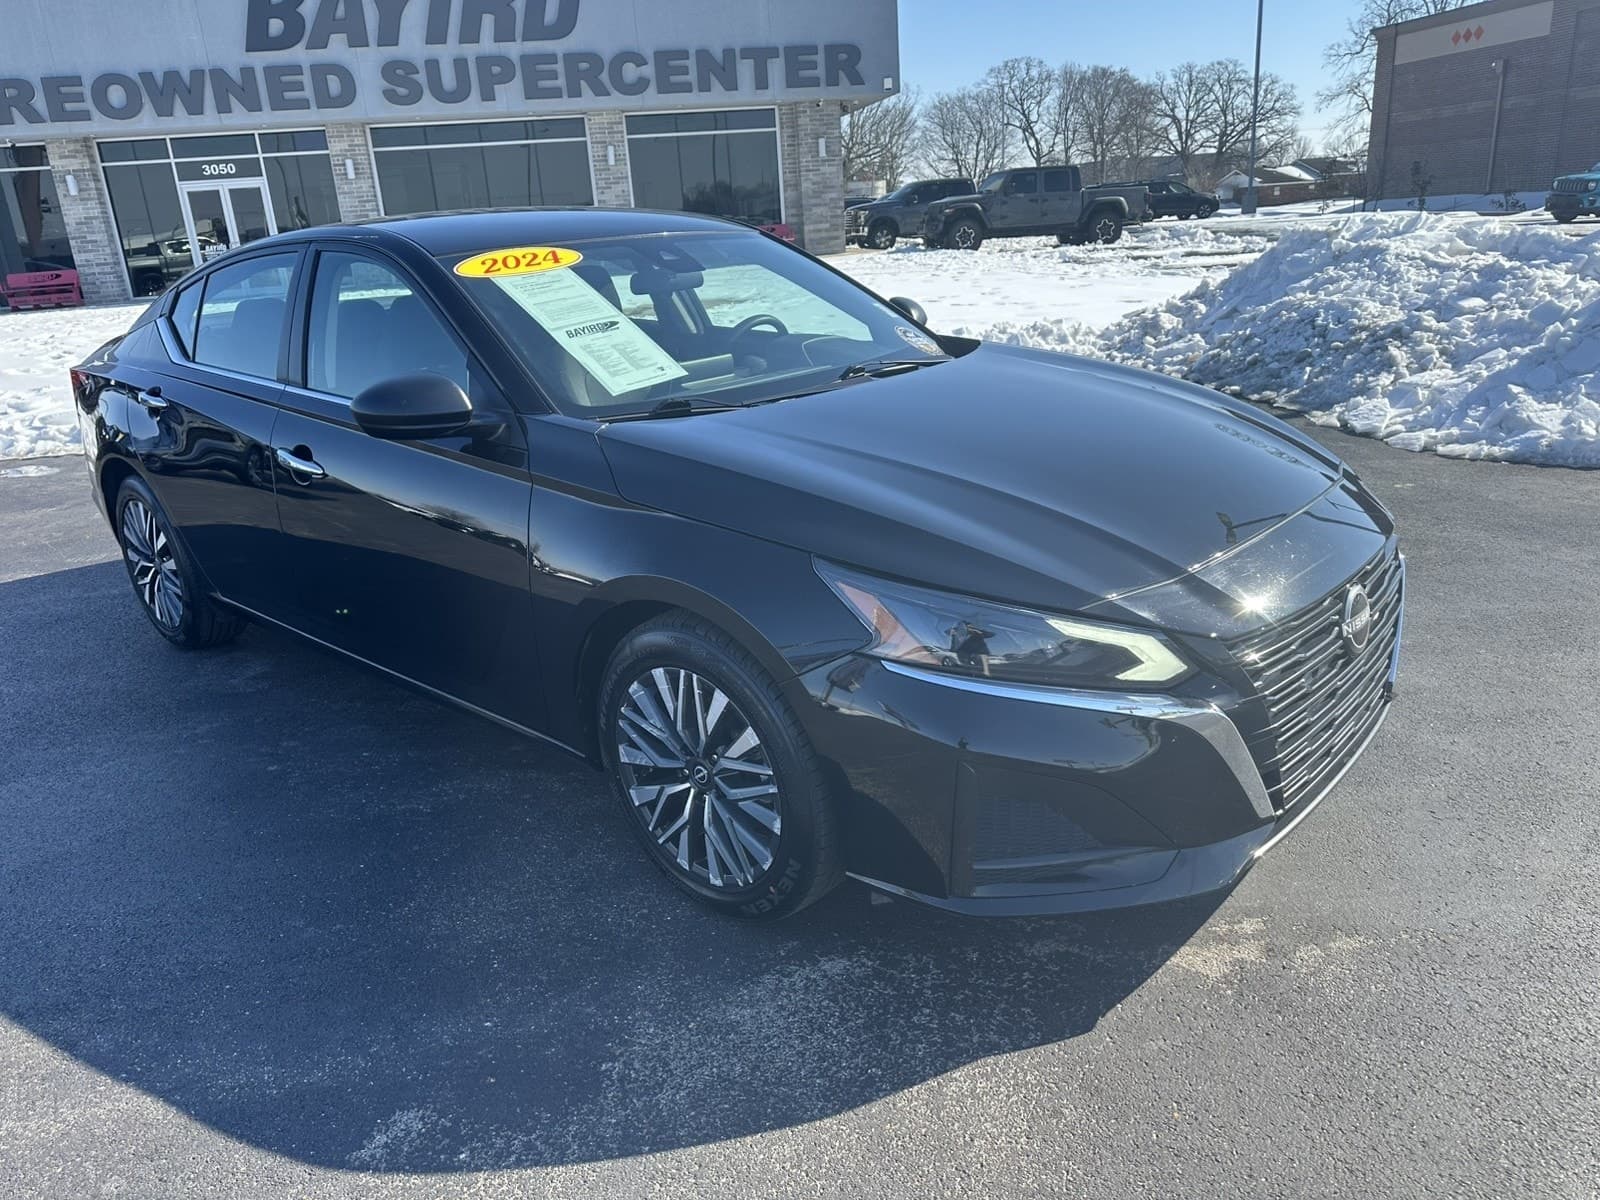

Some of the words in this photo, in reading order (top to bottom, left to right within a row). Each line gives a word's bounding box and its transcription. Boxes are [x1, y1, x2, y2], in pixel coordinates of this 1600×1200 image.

[0, 63, 357, 126] REOWNED
[380, 43, 866, 106] SUPERCENTER
[202, 163, 236, 175] 3050
[480, 250, 562, 274] 2024
[565, 322, 606, 339] BAYIRD
